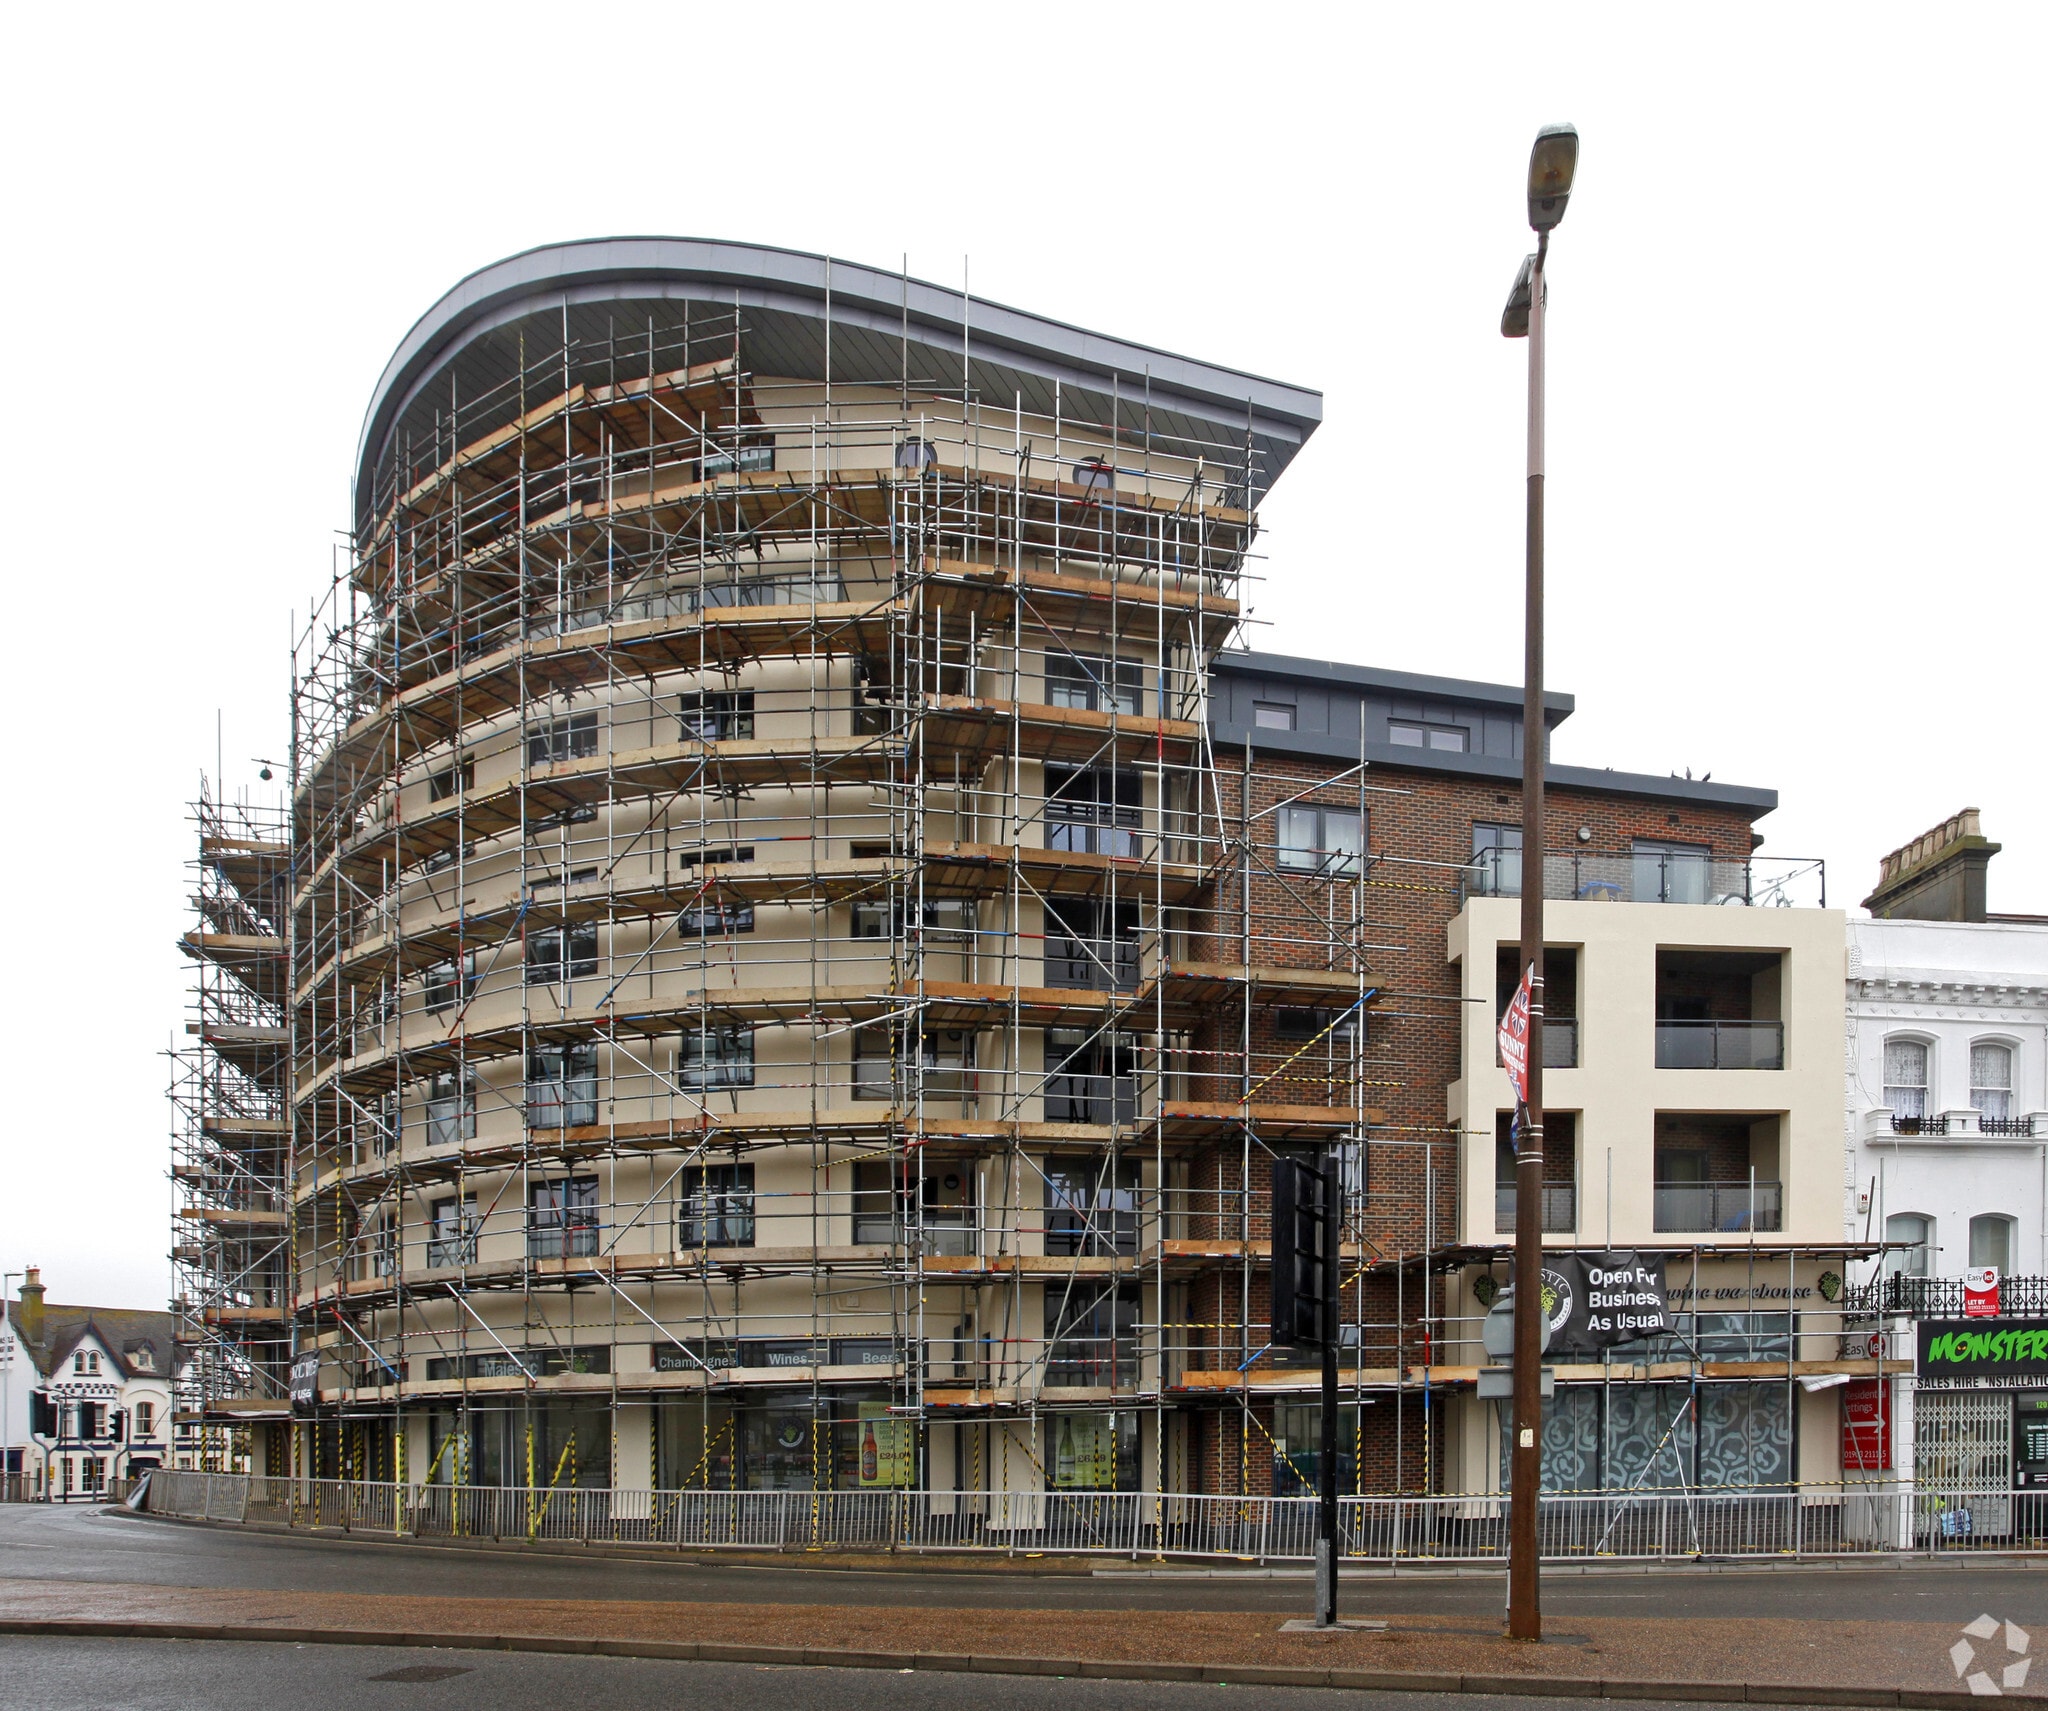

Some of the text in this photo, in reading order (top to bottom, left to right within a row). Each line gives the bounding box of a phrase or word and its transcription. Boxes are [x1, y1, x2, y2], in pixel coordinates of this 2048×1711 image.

[1500, 1029, 1526, 1060] SUNNY
[1589, 1267, 1632, 1288] Open
[1967, 1273, 1994, 1282] Easy let
[1714, 1283, 1811, 1299] waehouse
[1588, 1312, 1664, 1331] As Usual
[1844, 1342, 1865, 1357] Easy
[1928, 1329, 2048, 1363] MONSTER
[769, 1353, 808, 1365] Wines
[862, 1352, 901, 1364] Beers
[1917, 1376, 1950, 1389] SALES
[1954, 1376, 1979, 1388] HIRE
[1845, 1388, 1887, 1400] Residental
[1845, 1402, 1873, 1414] ettings
